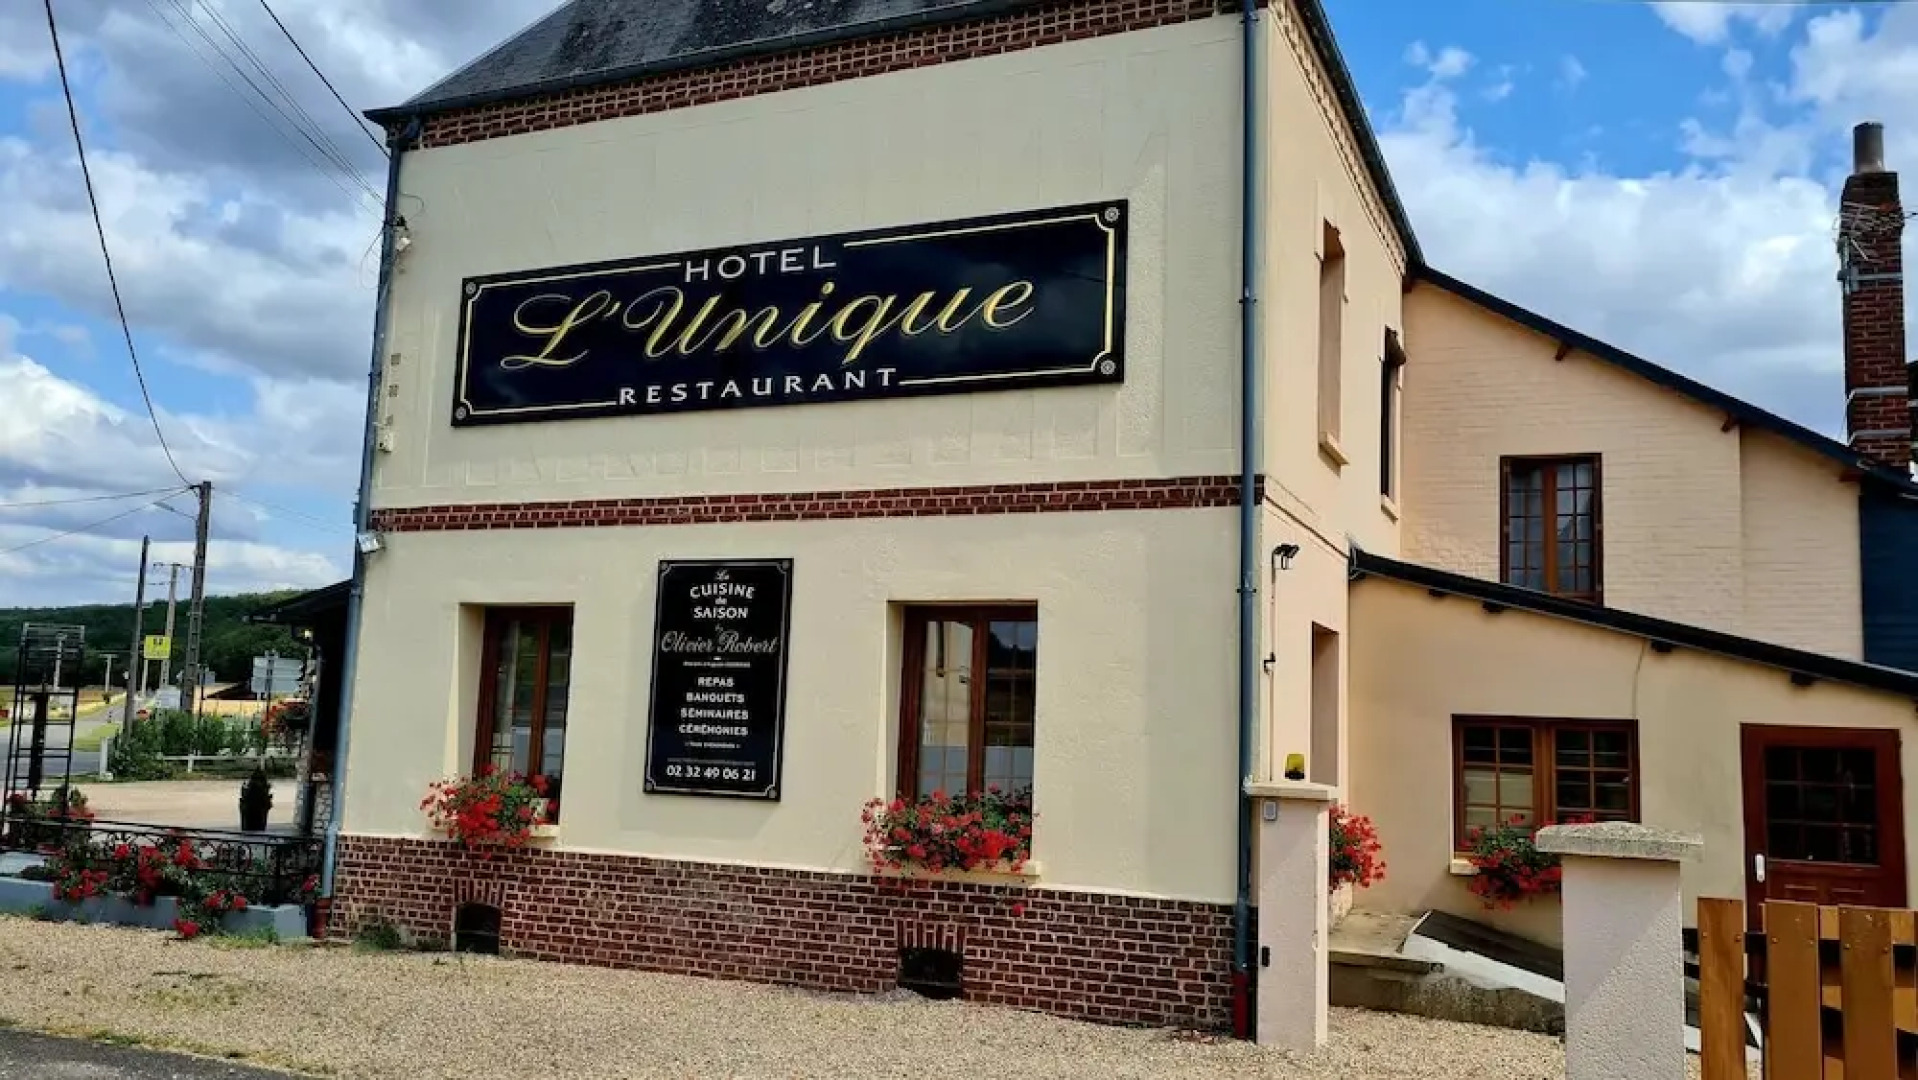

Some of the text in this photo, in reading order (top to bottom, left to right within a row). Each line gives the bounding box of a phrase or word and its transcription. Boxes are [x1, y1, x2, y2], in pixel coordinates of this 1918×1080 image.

[683, 245, 837, 283] HOTEL
[499, 279, 1036, 369] L'Unique
[619, 368, 897, 405] RESTAURANT
[689, 582, 756, 599] CUISINE
[693, 607, 749, 619] SAISON
[661, 630, 779, 653] Olivier Robert
[697, 676, 735, 688] REPAS
[686, 691, 745, 703] BANQUETS
[666, 764, 757, 781] 02 32 49 06 21
